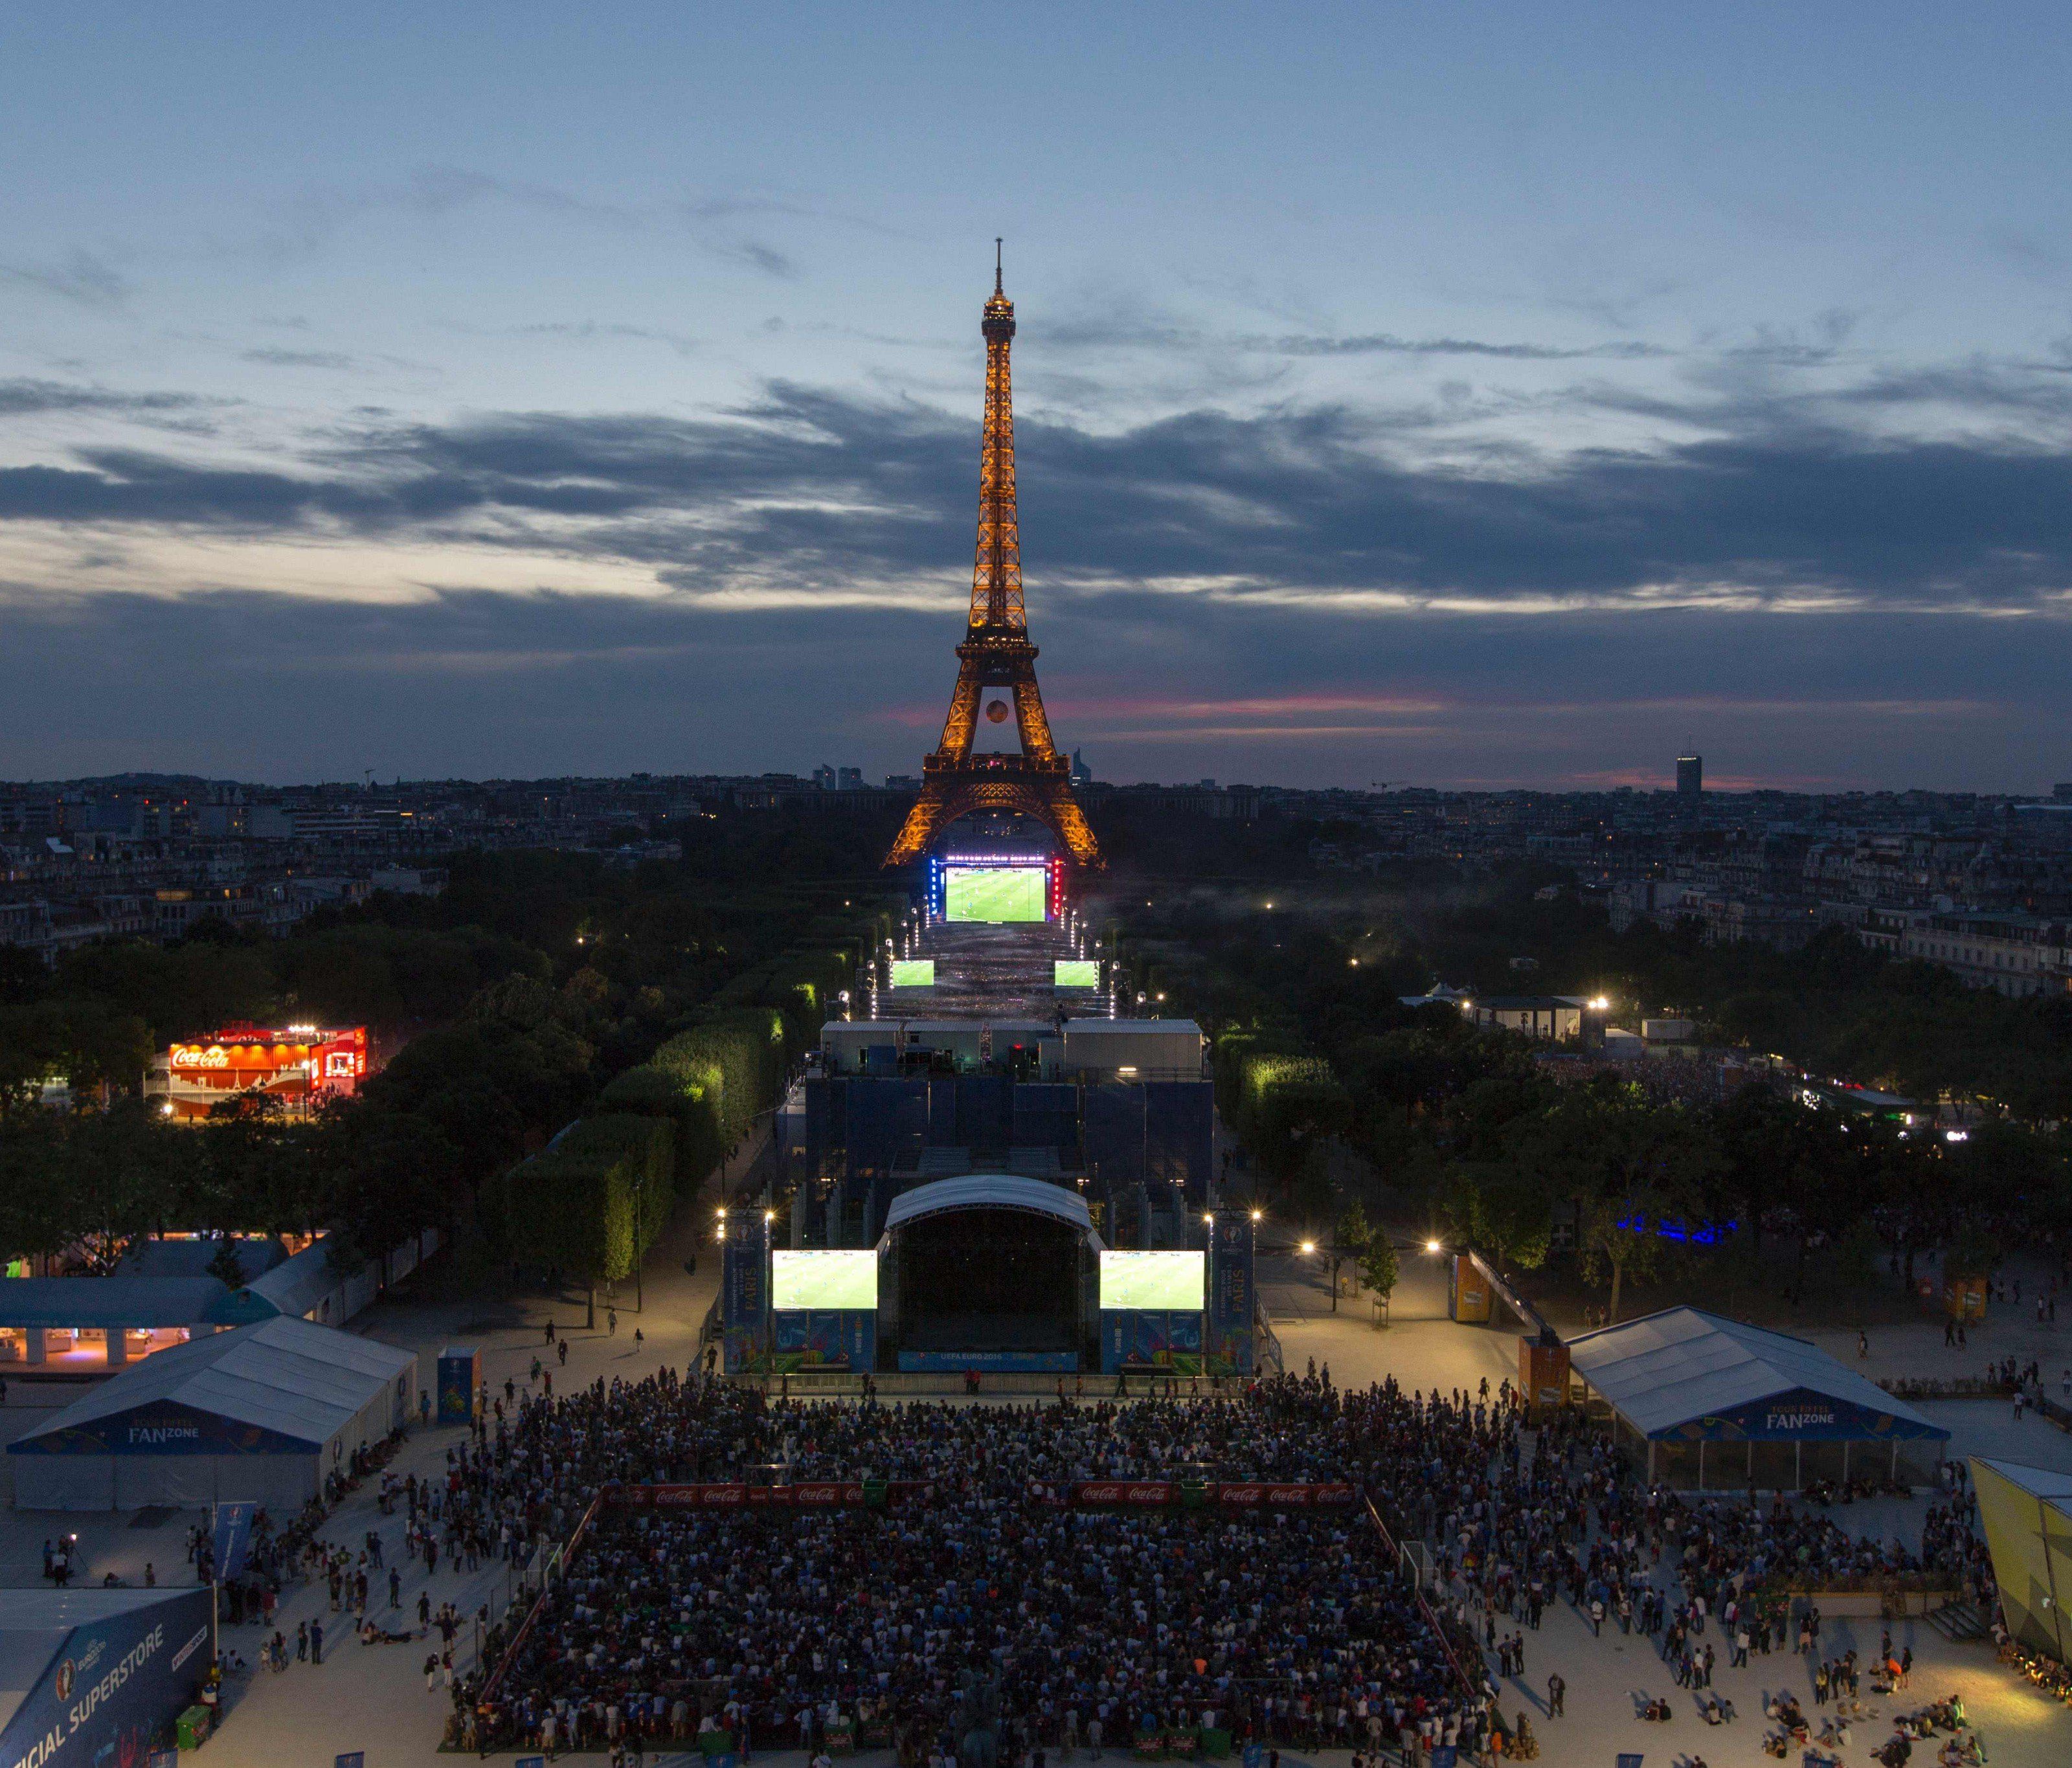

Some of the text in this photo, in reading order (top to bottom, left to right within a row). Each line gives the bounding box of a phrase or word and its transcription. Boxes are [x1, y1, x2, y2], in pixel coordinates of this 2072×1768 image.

[172, 1047, 229, 1067] Coca-Cola
[745, 1267, 757, 1311] PARIS
[1232, 1269, 1244, 1313] PARIS
[657, 1490, 693, 1503] Coca-Cola
[704, 1490, 741, 1503] Coca-Cola
[799, 1488, 836, 1501] Coca-Cola
[1082, 1487, 1119, 1499] Coca-Cola
[1129, 1487, 1167, 1500] Coca-Cola
[1222, 1488, 1260, 1501] Coca-Cola
[1270, 1488, 1308, 1501] Coca-Cola
[1317, 1488, 1353, 1502] Coca-Cola
[14, 1623, 164, 1768] ICIAL SUPERSTORE
